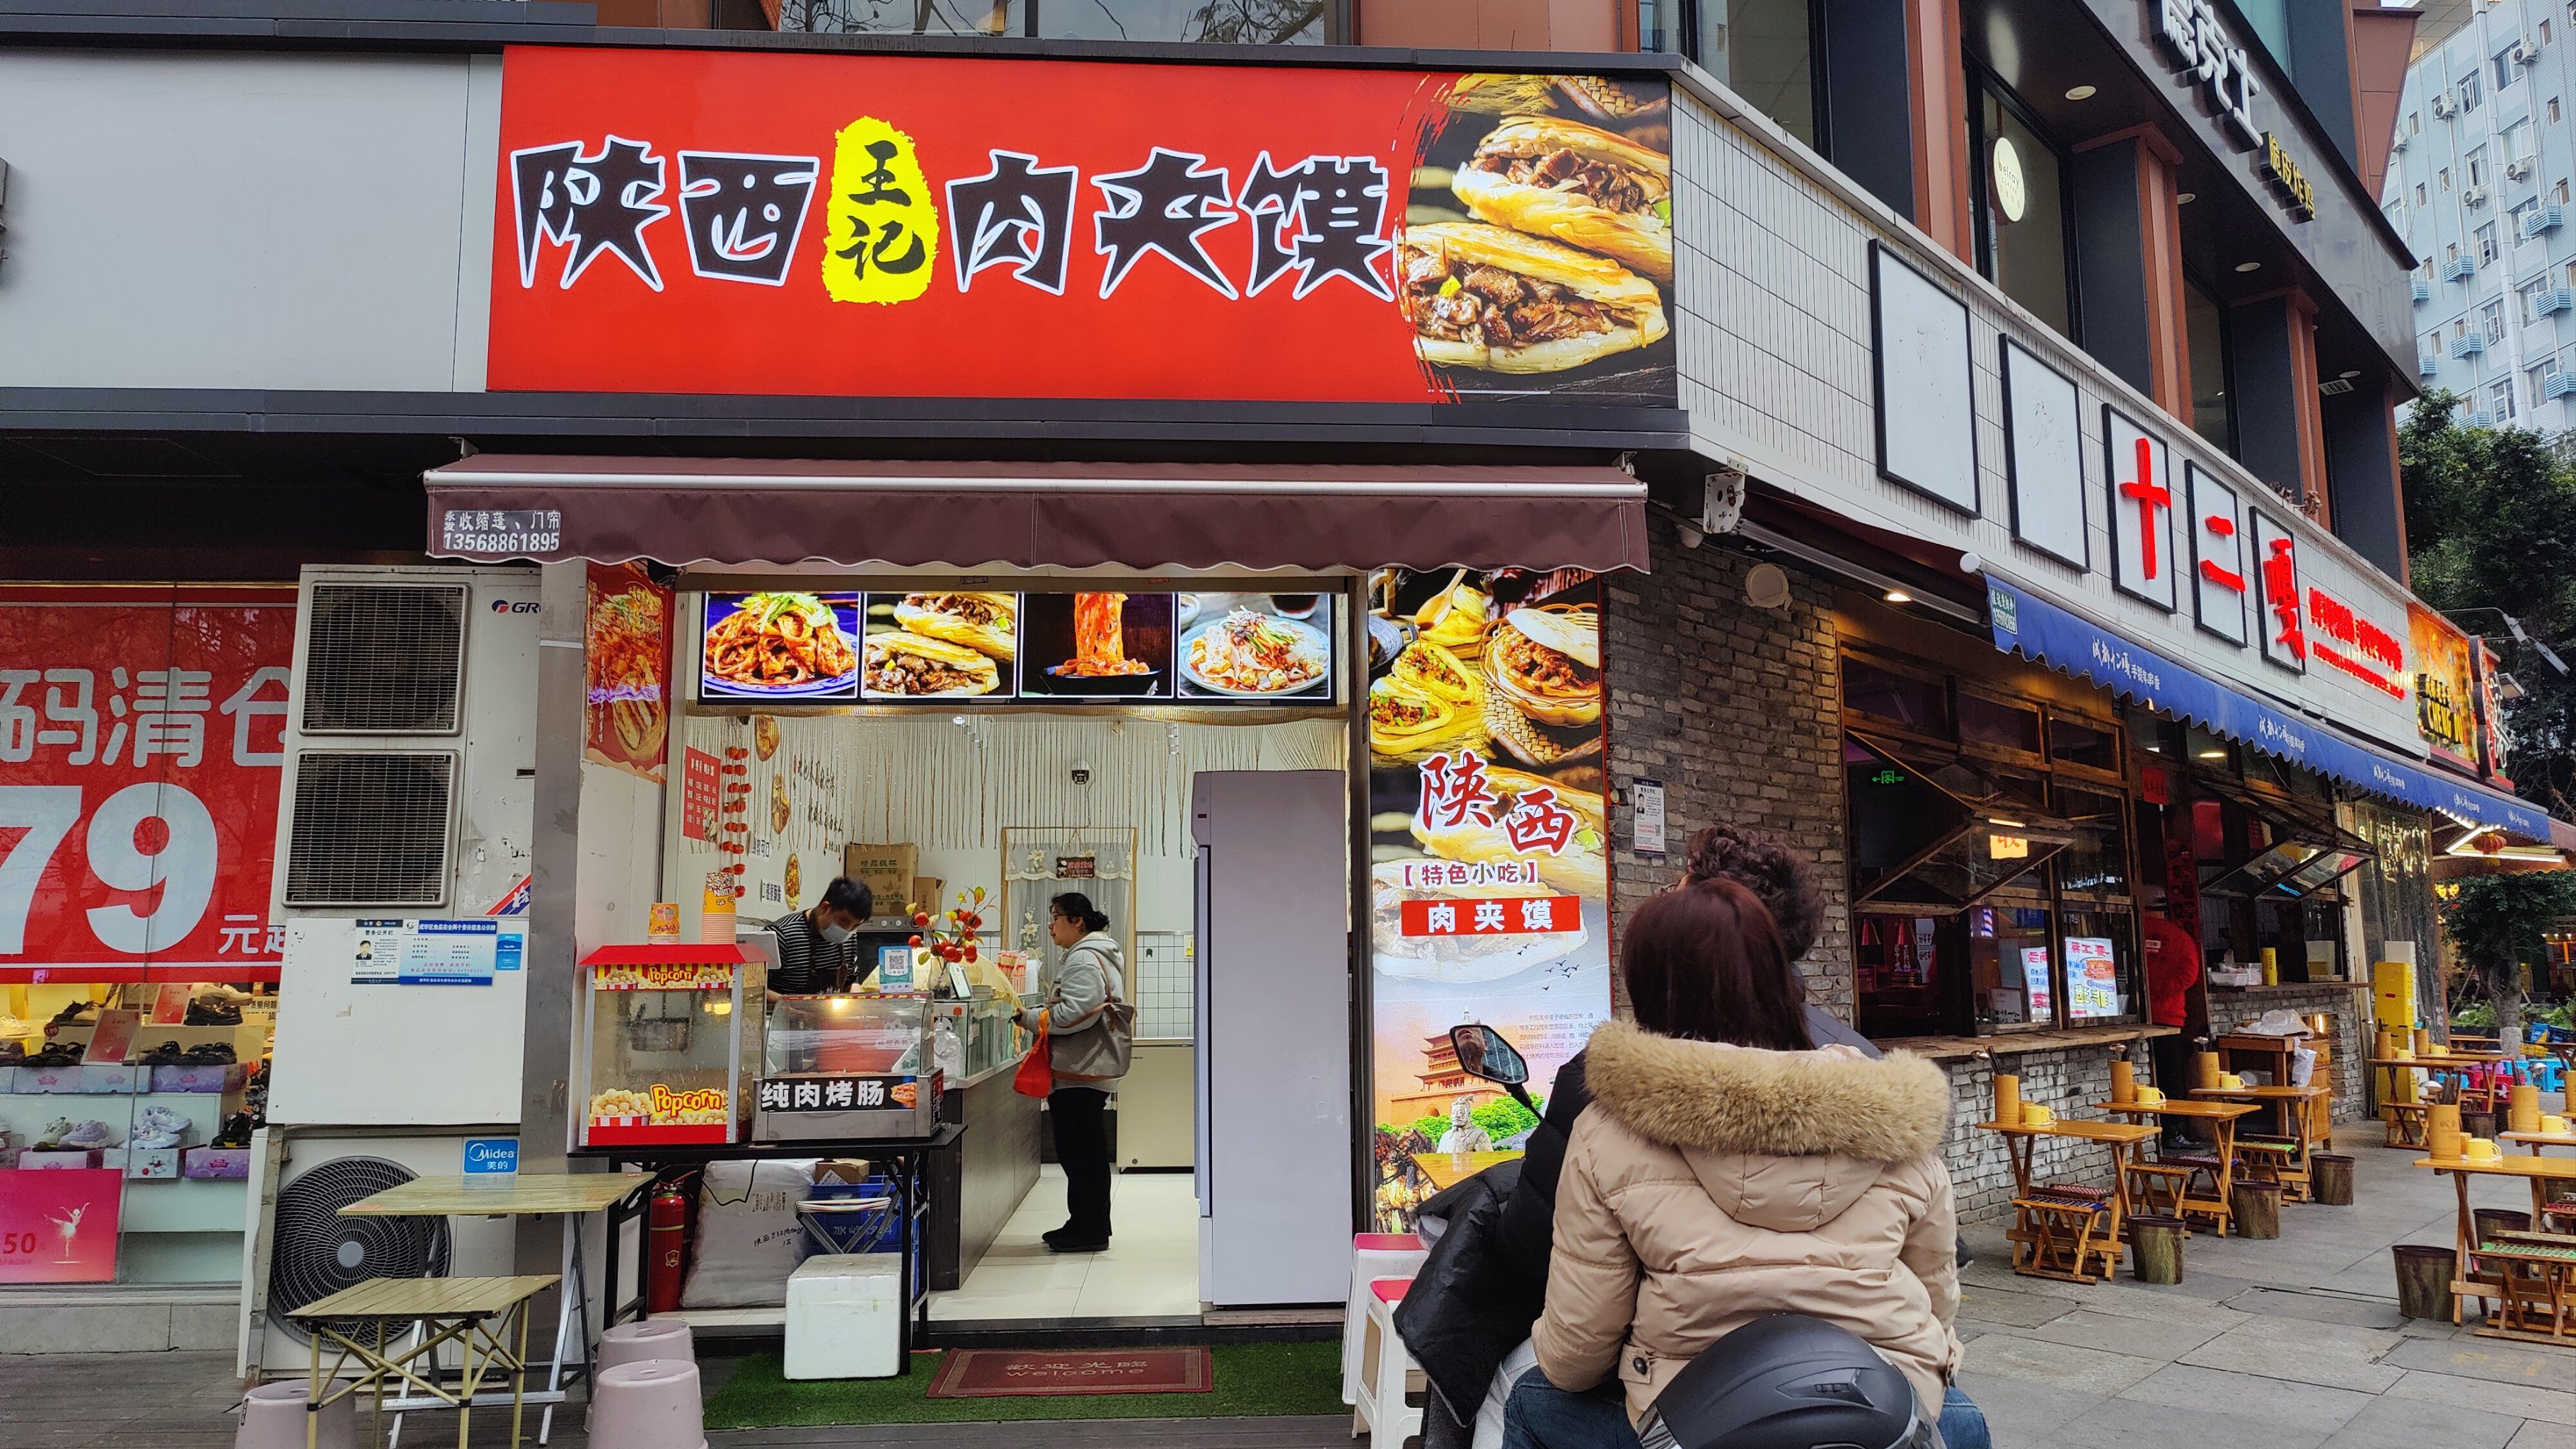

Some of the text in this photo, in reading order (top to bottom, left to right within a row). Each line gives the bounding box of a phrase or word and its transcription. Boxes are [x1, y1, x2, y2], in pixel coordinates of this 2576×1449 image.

[2268, 132, 2315, 220] 脆皮炸鸡
[509, 134, 1395, 302] 陕西 王记 肉夹馍
[444, 532, 560, 552] 13568861895
[512, 602, 541, 613] GR
[0, 666, 291, 768] 码清仓
[1421, 751, 1576, 854] 陕西
[0, 782, 217, 954] 79
[1428, 899, 1553, 933] 肉夹馍
[649, 966, 693, 986] Popcorn
[651, 1084, 722, 1118] Popcorn
[761, 1080, 884, 1108] 纯肉烤肠
[470, 1145, 515, 1161] Midea
[487, 1161, 508, 1170] 美的
[3, 1232, 35, 1254] 50
[1005, 1361, 1148, 1370] 歡迎光臨
[1006, 1368, 1145, 1377] welcome
